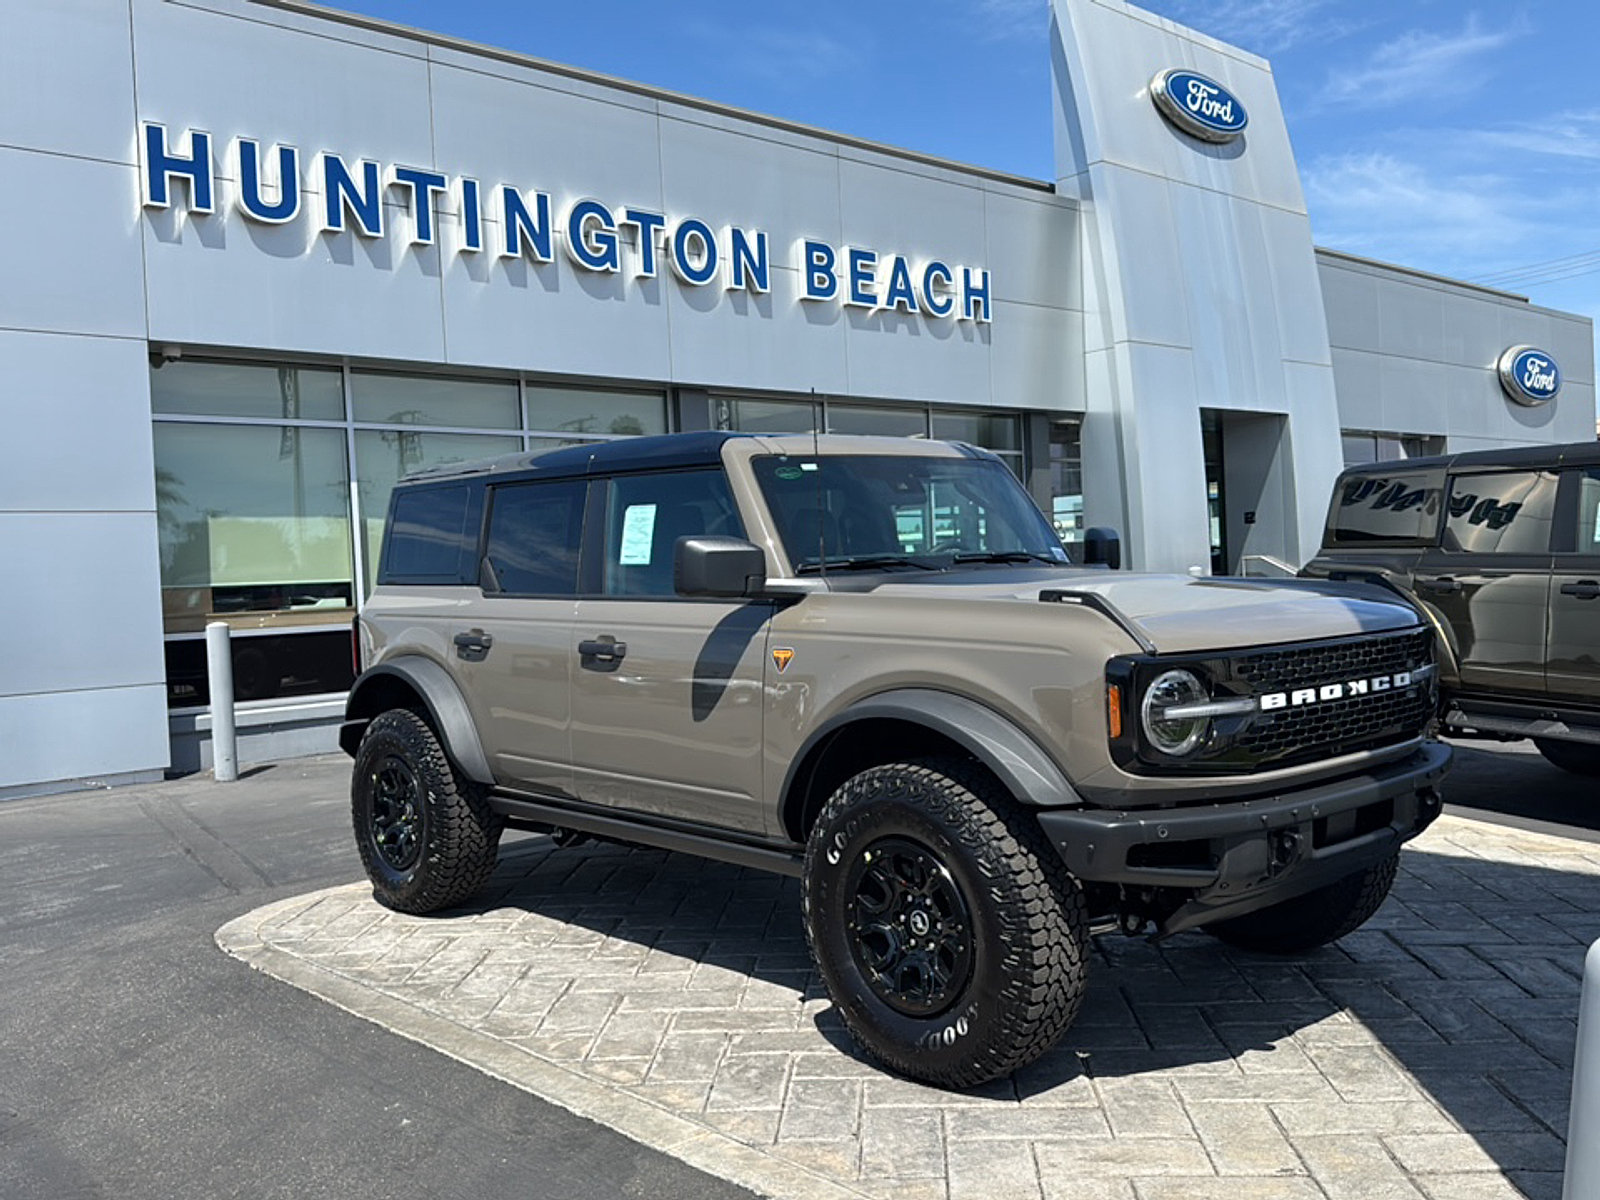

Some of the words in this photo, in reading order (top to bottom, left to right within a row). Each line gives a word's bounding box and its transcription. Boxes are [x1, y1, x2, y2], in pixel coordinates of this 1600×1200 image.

[1186, 79, 1235, 123] Ford
[142, 120, 771, 294] HUNTINGTON
[801, 237, 992, 323] BEACH
[1523, 357, 1556, 391] Ford
[1260, 672, 1411, 710] BRONCO
